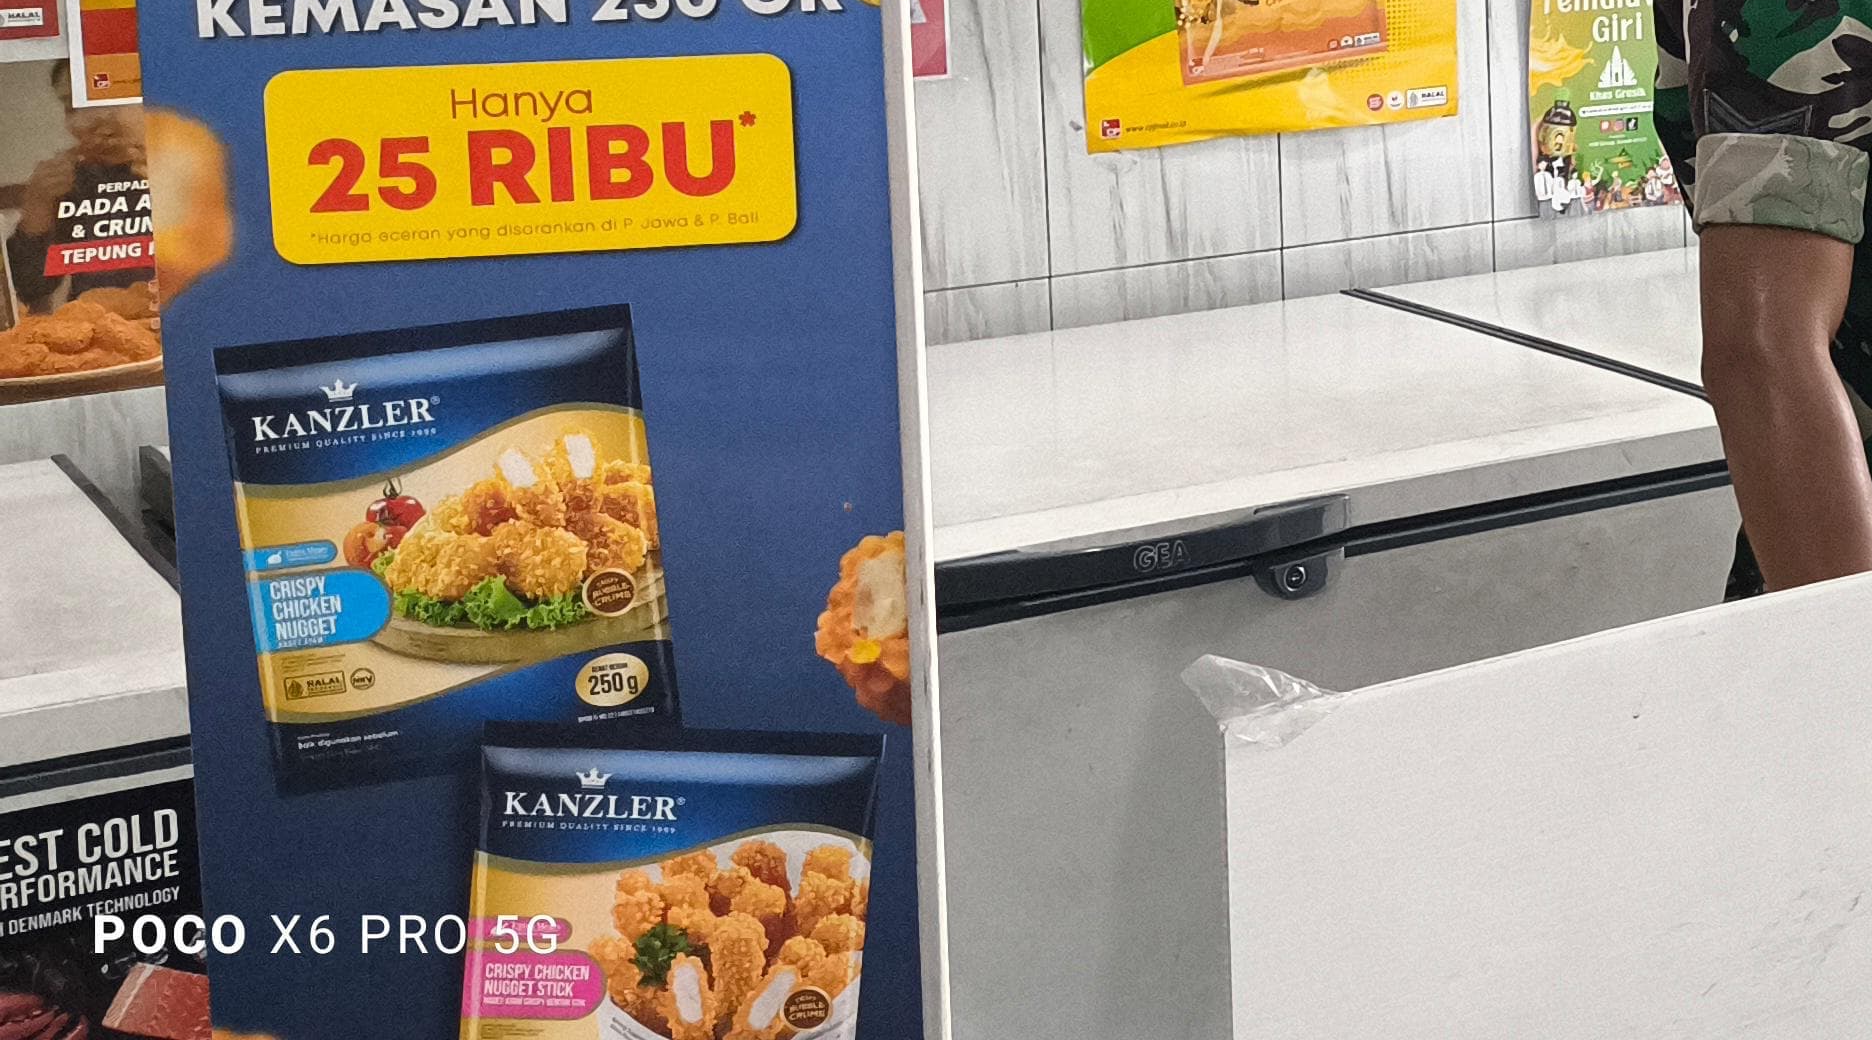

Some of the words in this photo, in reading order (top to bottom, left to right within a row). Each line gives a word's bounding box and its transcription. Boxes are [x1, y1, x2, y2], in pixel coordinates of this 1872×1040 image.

[1592, 11, 1644, 43] Giri
[449, 86, 595, 124] Hanya
[306, 135, 438, 215] 25
[58, 196, 129, 219] DADA
[71, 224, 86, 239] &
[378, 228, 441, 243] eceran
[446, 225, 491, 242] yang
[496, 218, 596, 238] disarankan
[600, 216, 617, 232] di
[640, 216, 689, 230] Jawa
[60, 242, 142, 265] TEPUNG
[1132, 539, 1190, 573] GEA
[269, 575, 326, 600] CRISPY
[272, 593, 343, 621] CHICKEN
[275, 615, 338, 641] NUGGET
[587, 672, 624, 697] 250
[626, 674, 639, 696] g
[77, 807, 180, 865] COLD
[8, 905, 84, 936] DENMARK
[86, 885, 181, 918] TECHNOLOGY
[485, 963, 531, 979] CRISPY
[534, 964, 591, 981] CHICKEN
[484, 978, 535, 996] NUGGET
[537, 981, 574, 997] STICK
